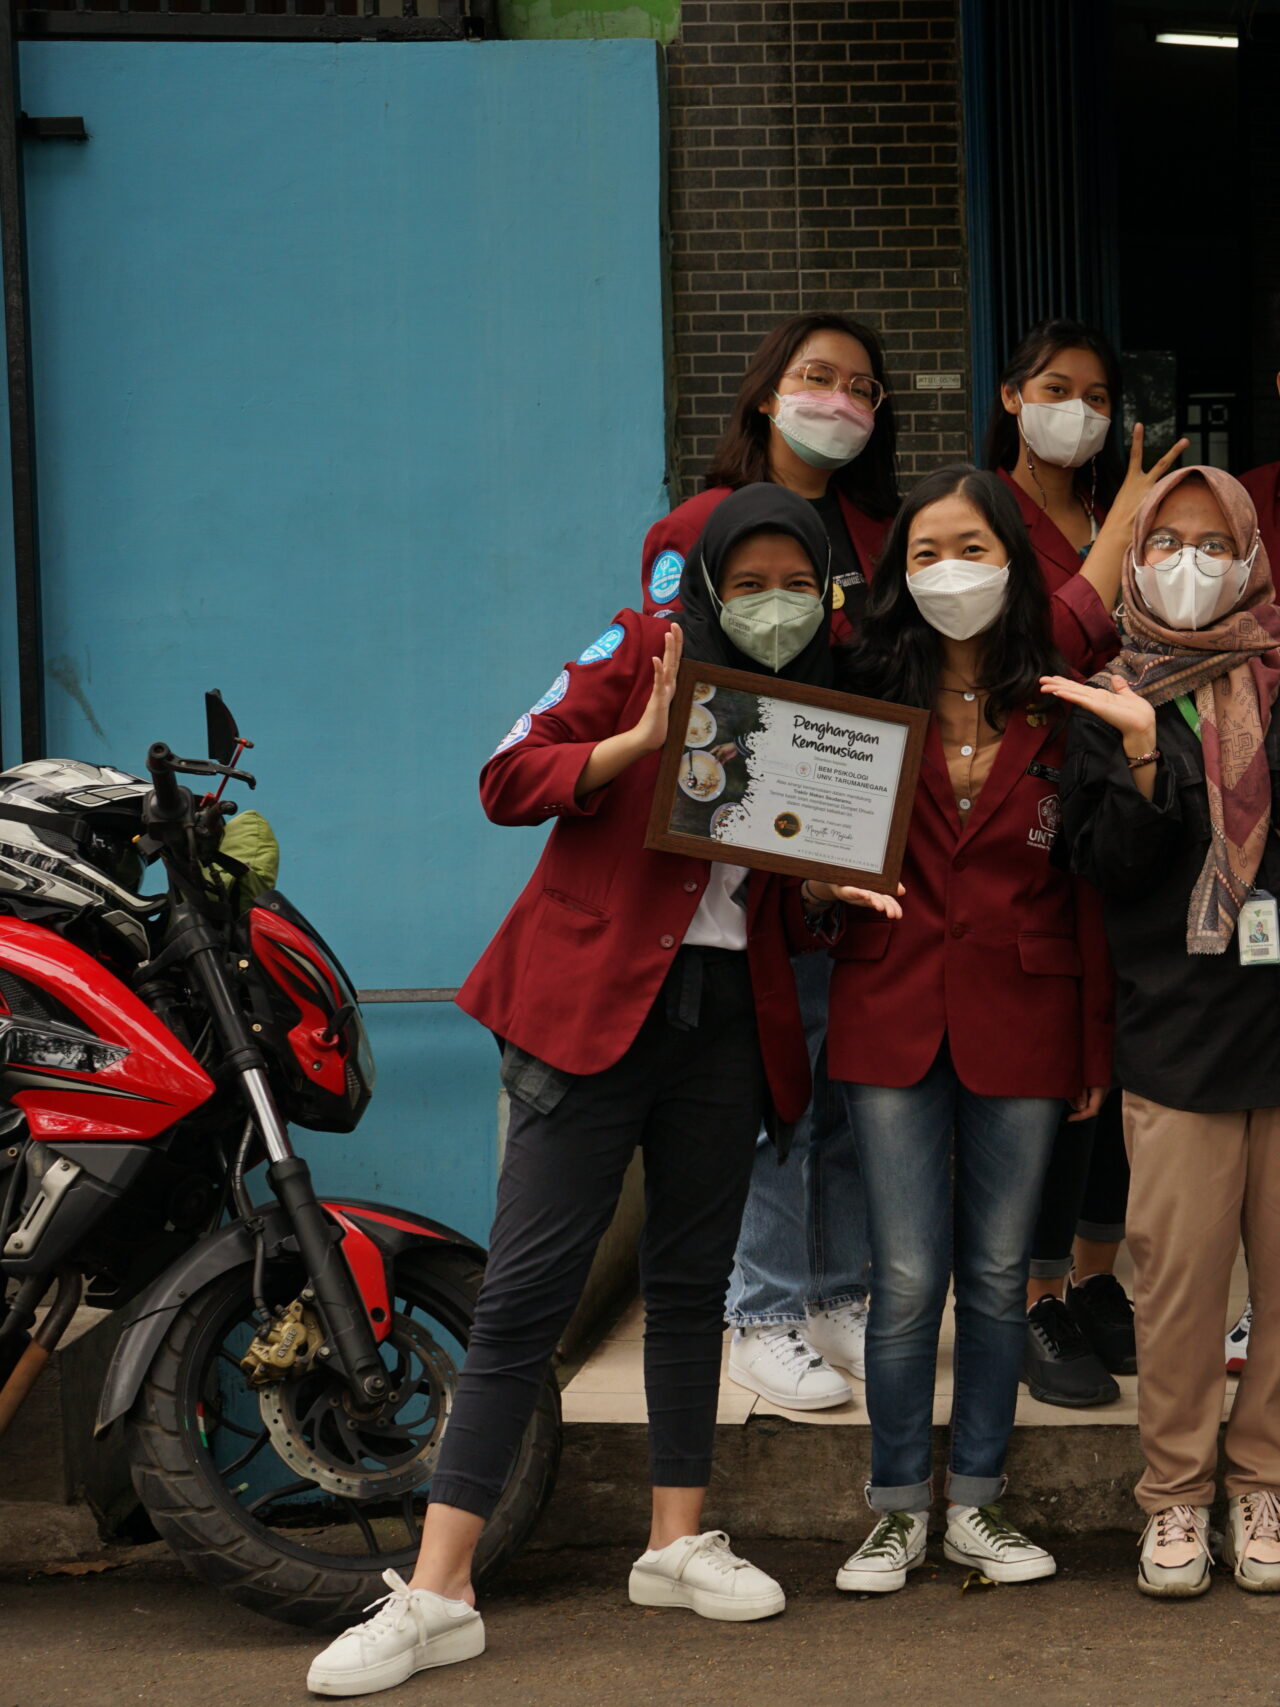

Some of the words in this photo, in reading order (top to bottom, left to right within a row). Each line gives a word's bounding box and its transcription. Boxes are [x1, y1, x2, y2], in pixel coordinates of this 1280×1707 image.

[793, 714, 879, 747] Penghargaan
[791, 733, 873, 762] Kemanusiaan
[818, 765, 833, 775] BEM
[833, 768, 869, 781] PSIKOLOGI
[835, 776, 888, 793] TARUMANEGARA
